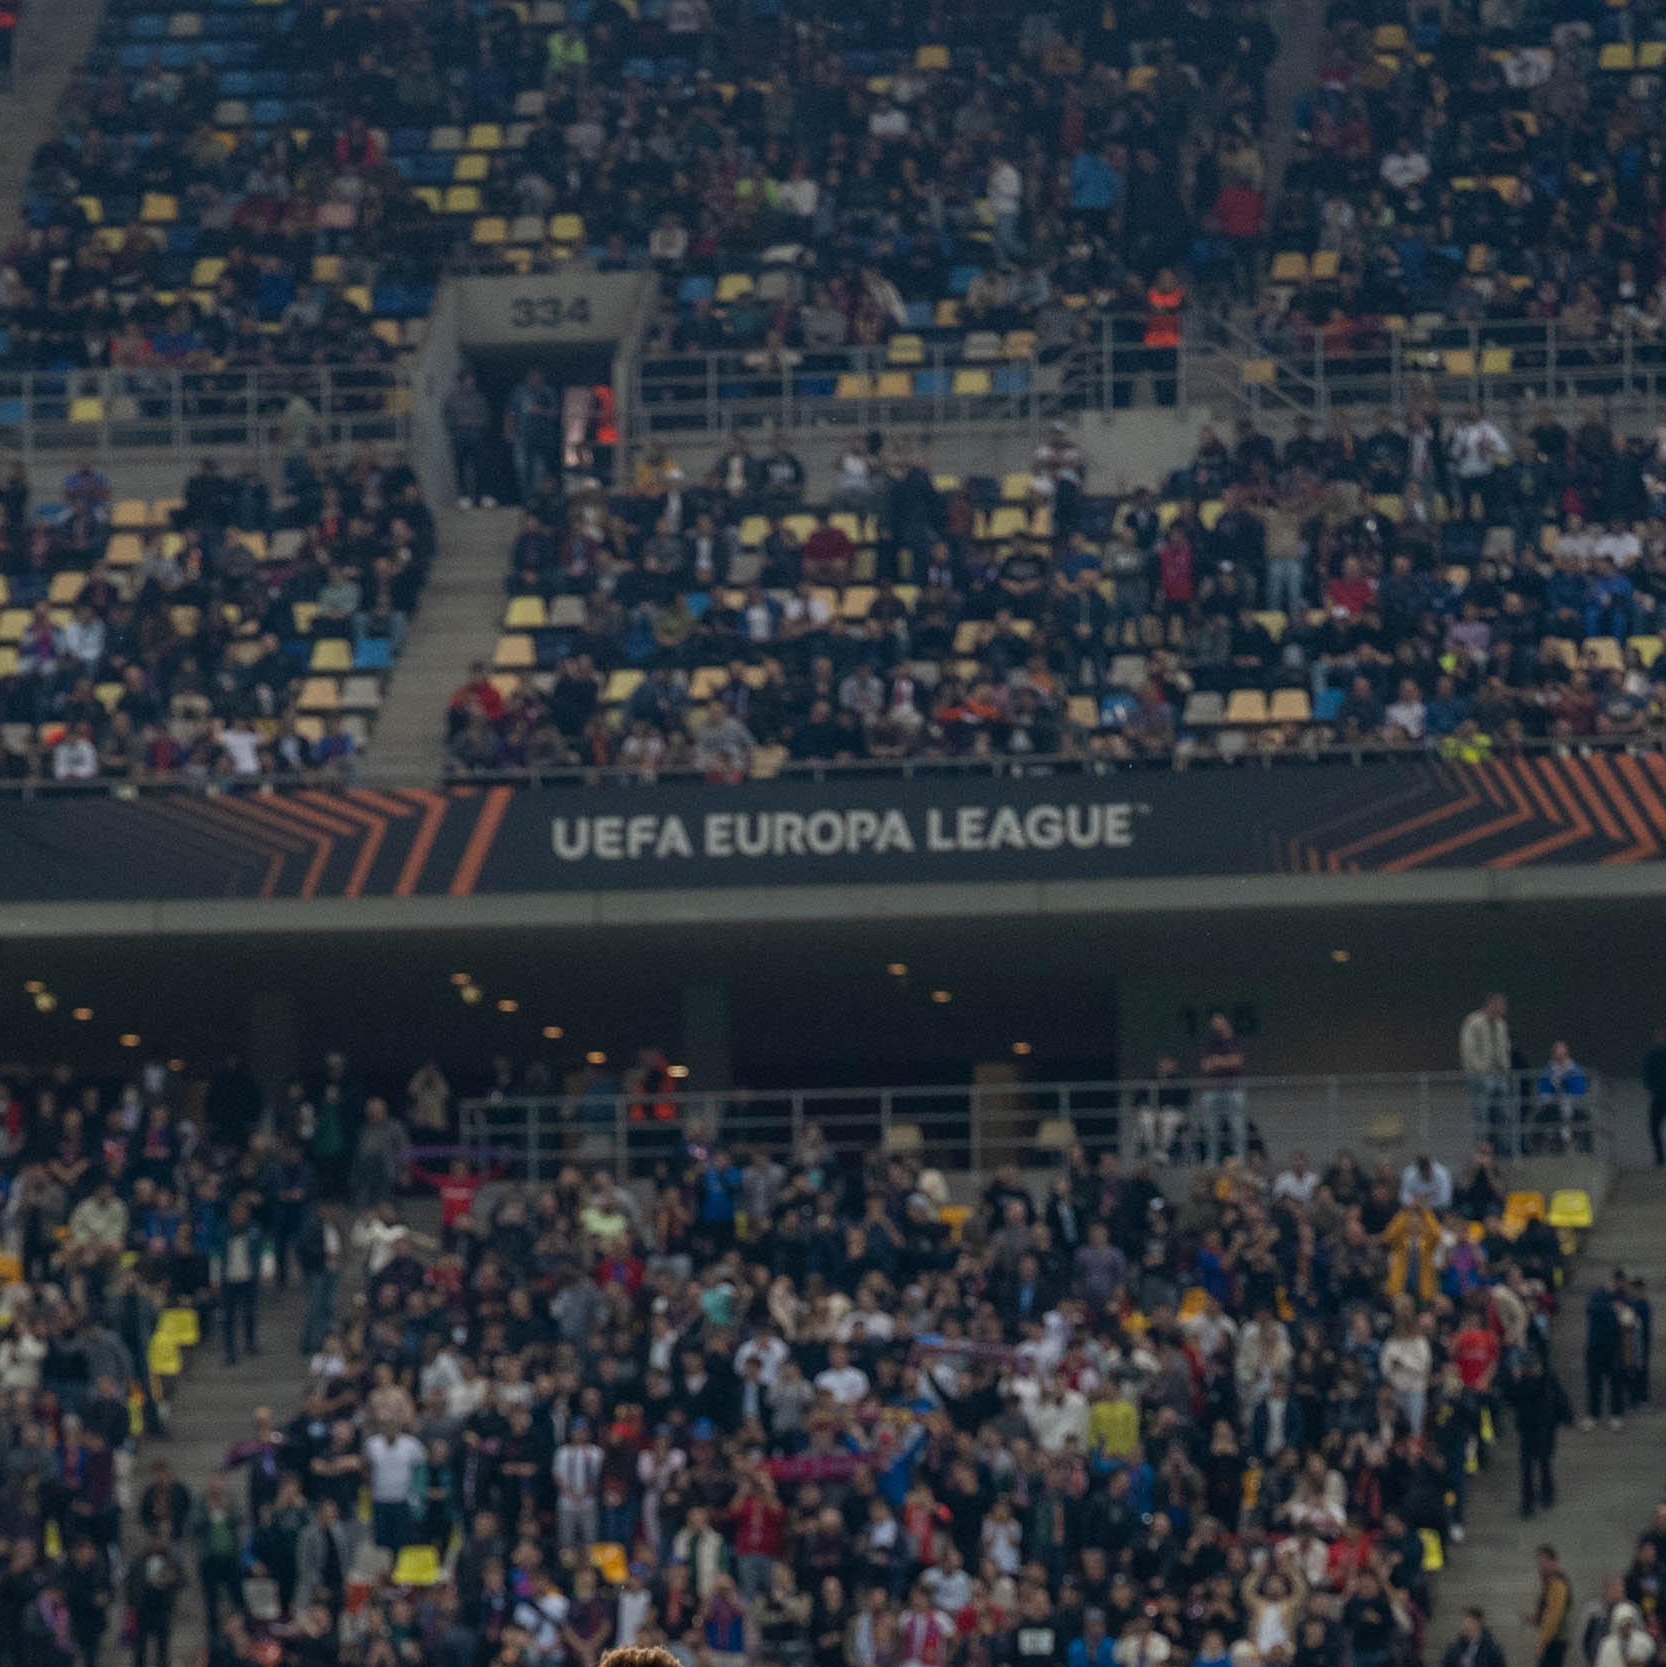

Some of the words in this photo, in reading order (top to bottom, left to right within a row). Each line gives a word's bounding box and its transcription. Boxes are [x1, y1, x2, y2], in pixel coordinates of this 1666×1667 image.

[510, 296, 592, 331] 334
[551, 815, 693, 861] UEFA
[704, 810, 915, 857] EUROPA
[926, 803, 1134, 852] LEAGUE
